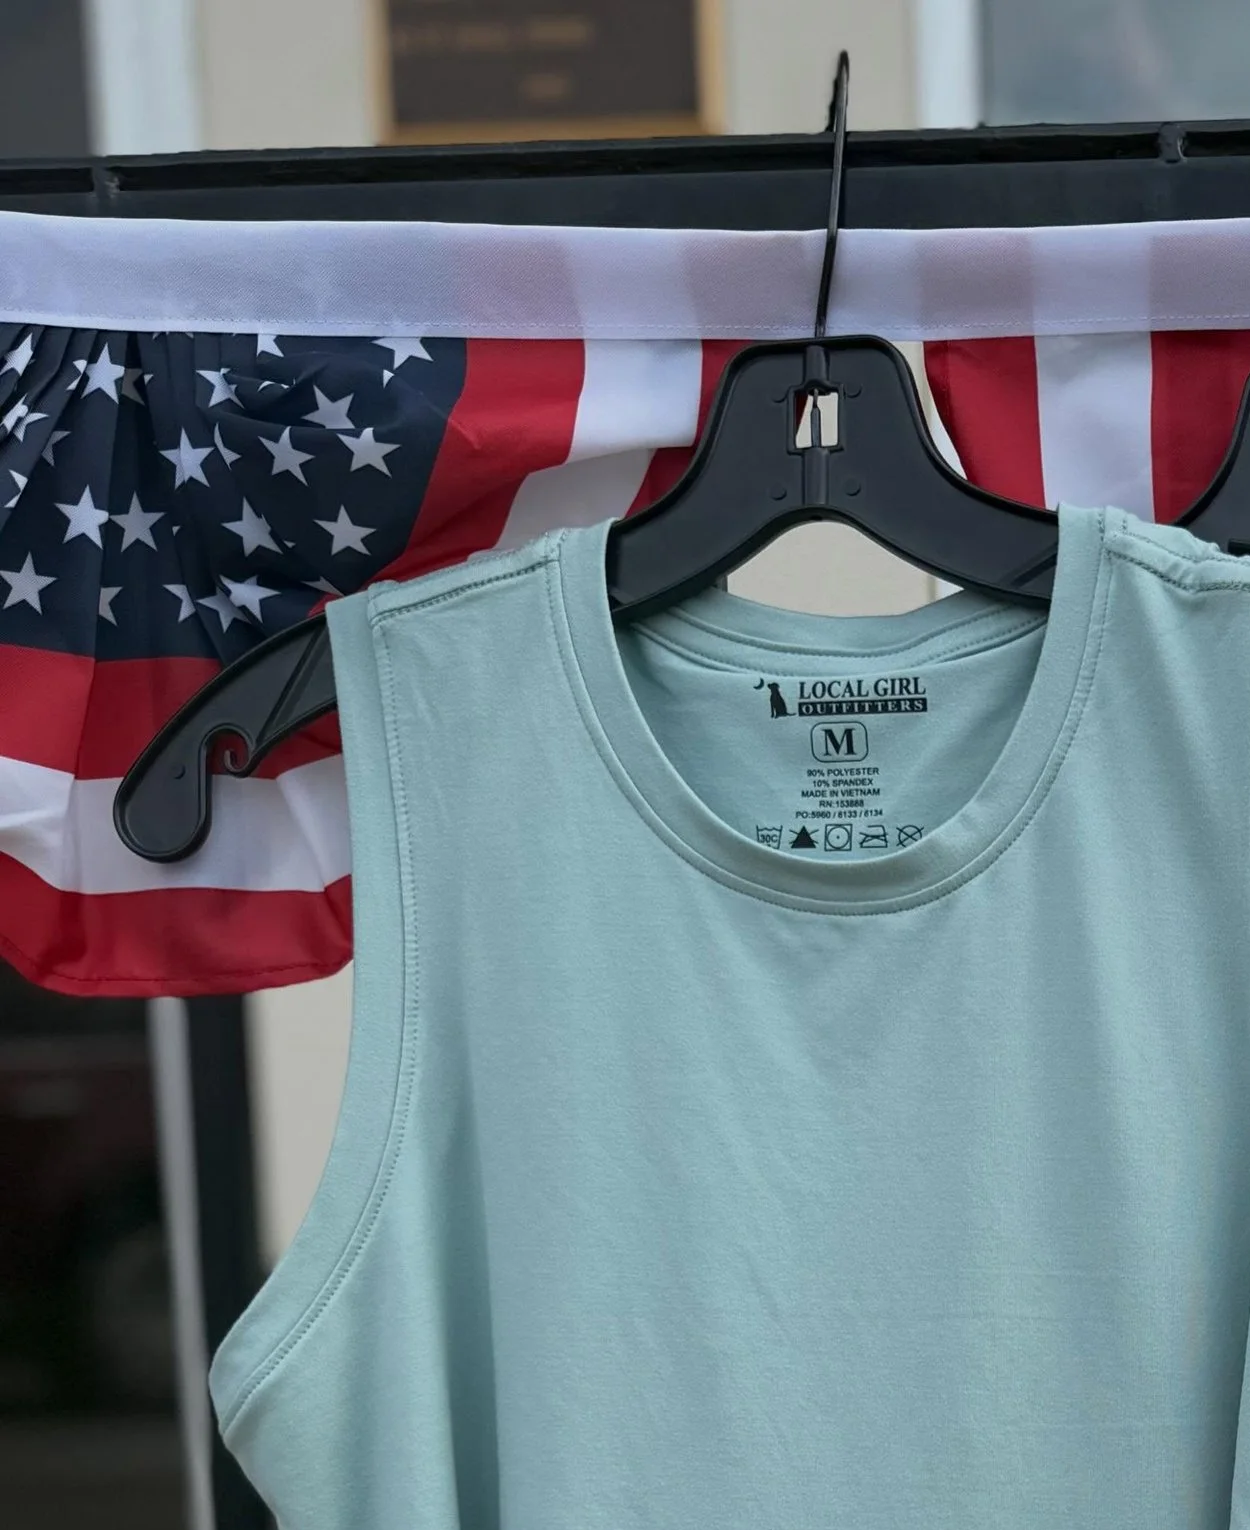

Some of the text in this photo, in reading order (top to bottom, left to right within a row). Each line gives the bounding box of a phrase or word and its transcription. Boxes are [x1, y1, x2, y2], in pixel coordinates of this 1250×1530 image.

[798, 677, 926, 700] LOCAL GIRL
[801, 701, 924, 715] OUTFITTERS
[822, 728, 857, 756] M
[807, 767, 879, 777] 90% POLYESTER
[813, 778, 873, 787] 10% SPANDEX
[801, 788, 880, 798] MADE IN VIETNAM
